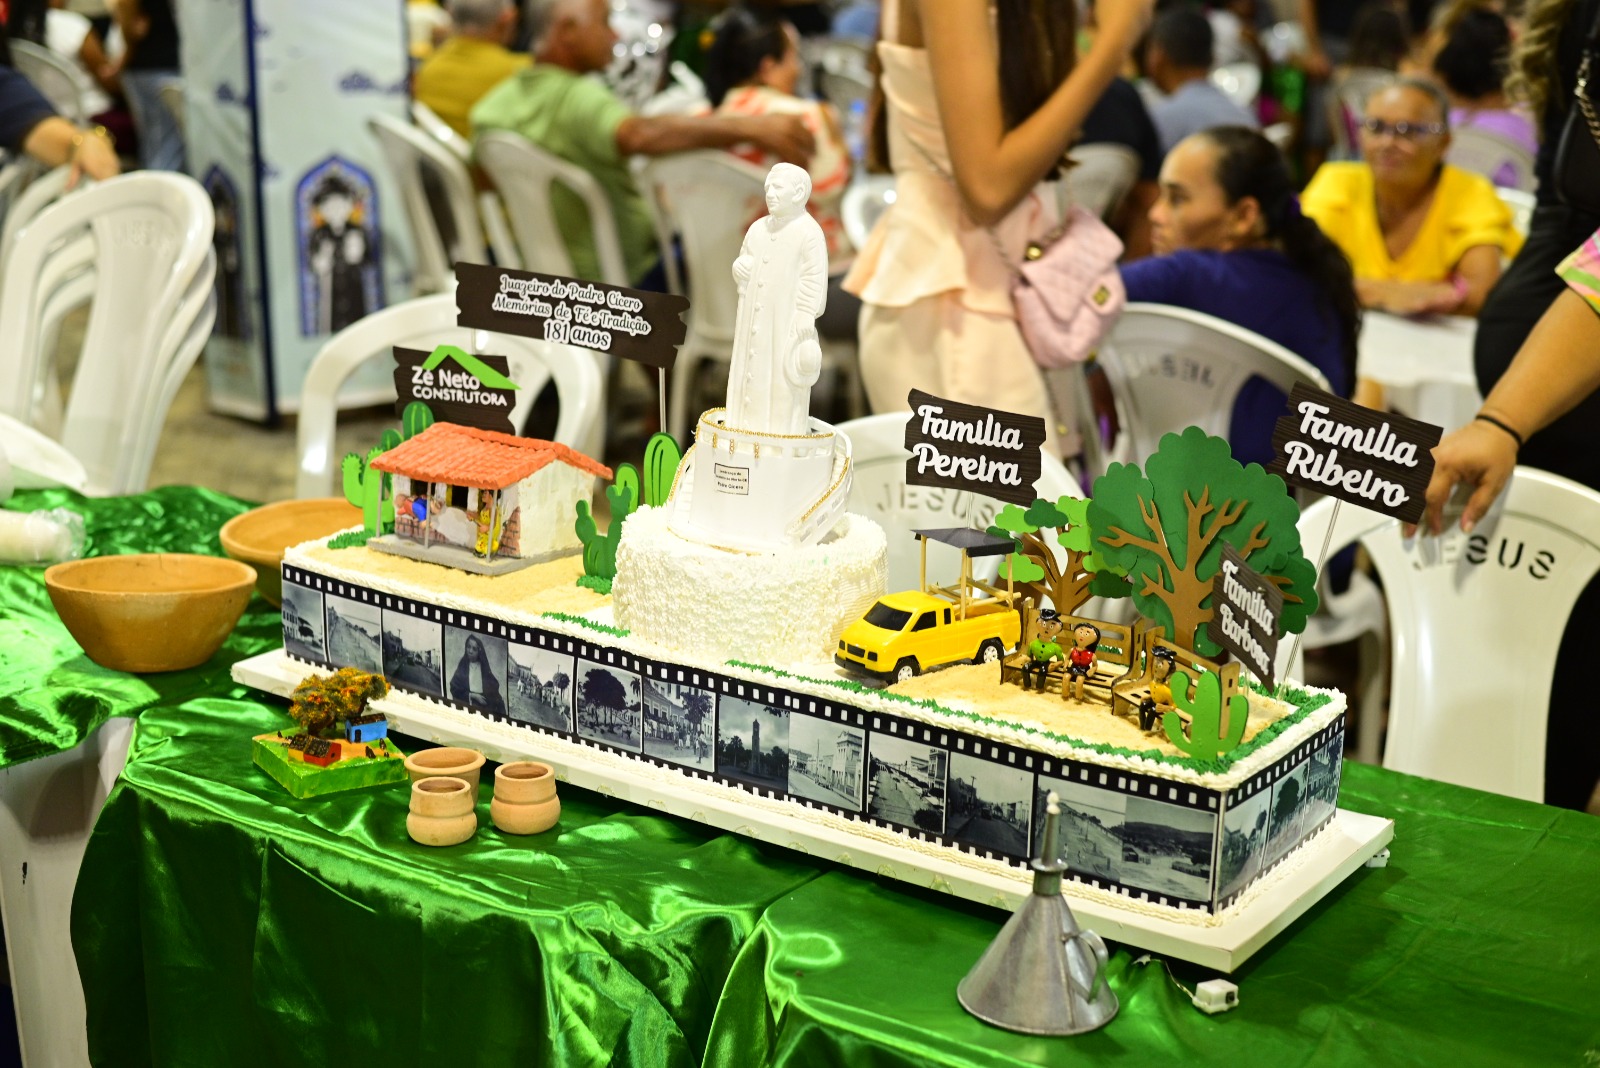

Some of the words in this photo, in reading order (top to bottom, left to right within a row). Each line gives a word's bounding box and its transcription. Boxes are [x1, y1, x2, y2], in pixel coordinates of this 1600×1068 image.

[501, 275, 549, 296] Juazeiro
[551, 280, 566, 296] do
[568, 283, 604, 301] Padre
[608, 292, 641, 310] Cícero
[493, 295, 551, 315] Memórias
[555, 302, 571, 319] de
[575, 306, 591, 322] Fé
[591, 313, 599, 323] e
[600, 311, 650, 333] Tradição
[545, 321, 569, 341] 181
[572, 327, 610, 348] anos
[412, 385, 507, 407] CONSTRUTORA
[438, 368, 480, 390] Neto
[912, 442, 1021, 486] Pereira
[1284, 441, 1409, 507] Ribeiro
[1219, 603, 1270, 676] Barbosa
